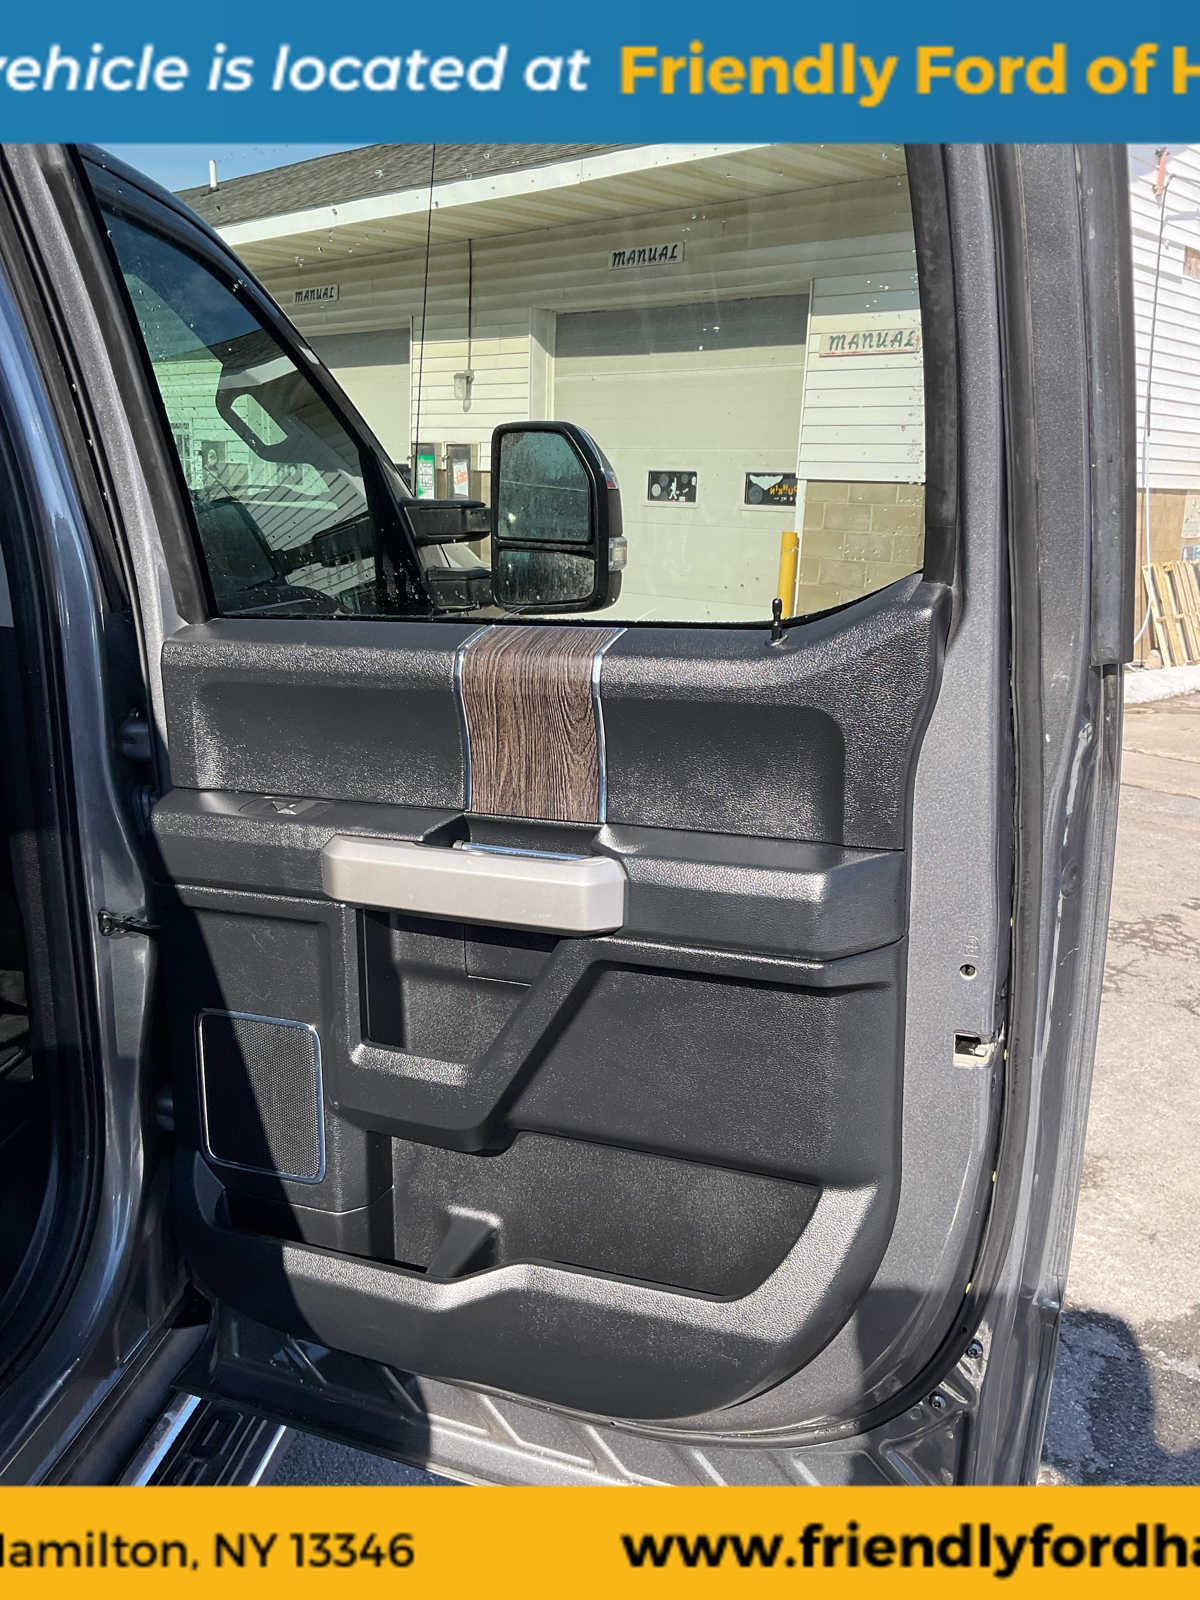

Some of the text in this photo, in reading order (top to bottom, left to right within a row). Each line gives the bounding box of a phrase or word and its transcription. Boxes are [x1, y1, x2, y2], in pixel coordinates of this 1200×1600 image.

[612, 244, 678, 266] MANUAL
[295, 286, 334, 303] MANUAL
[828, 330, 916, 352] MANUAL
